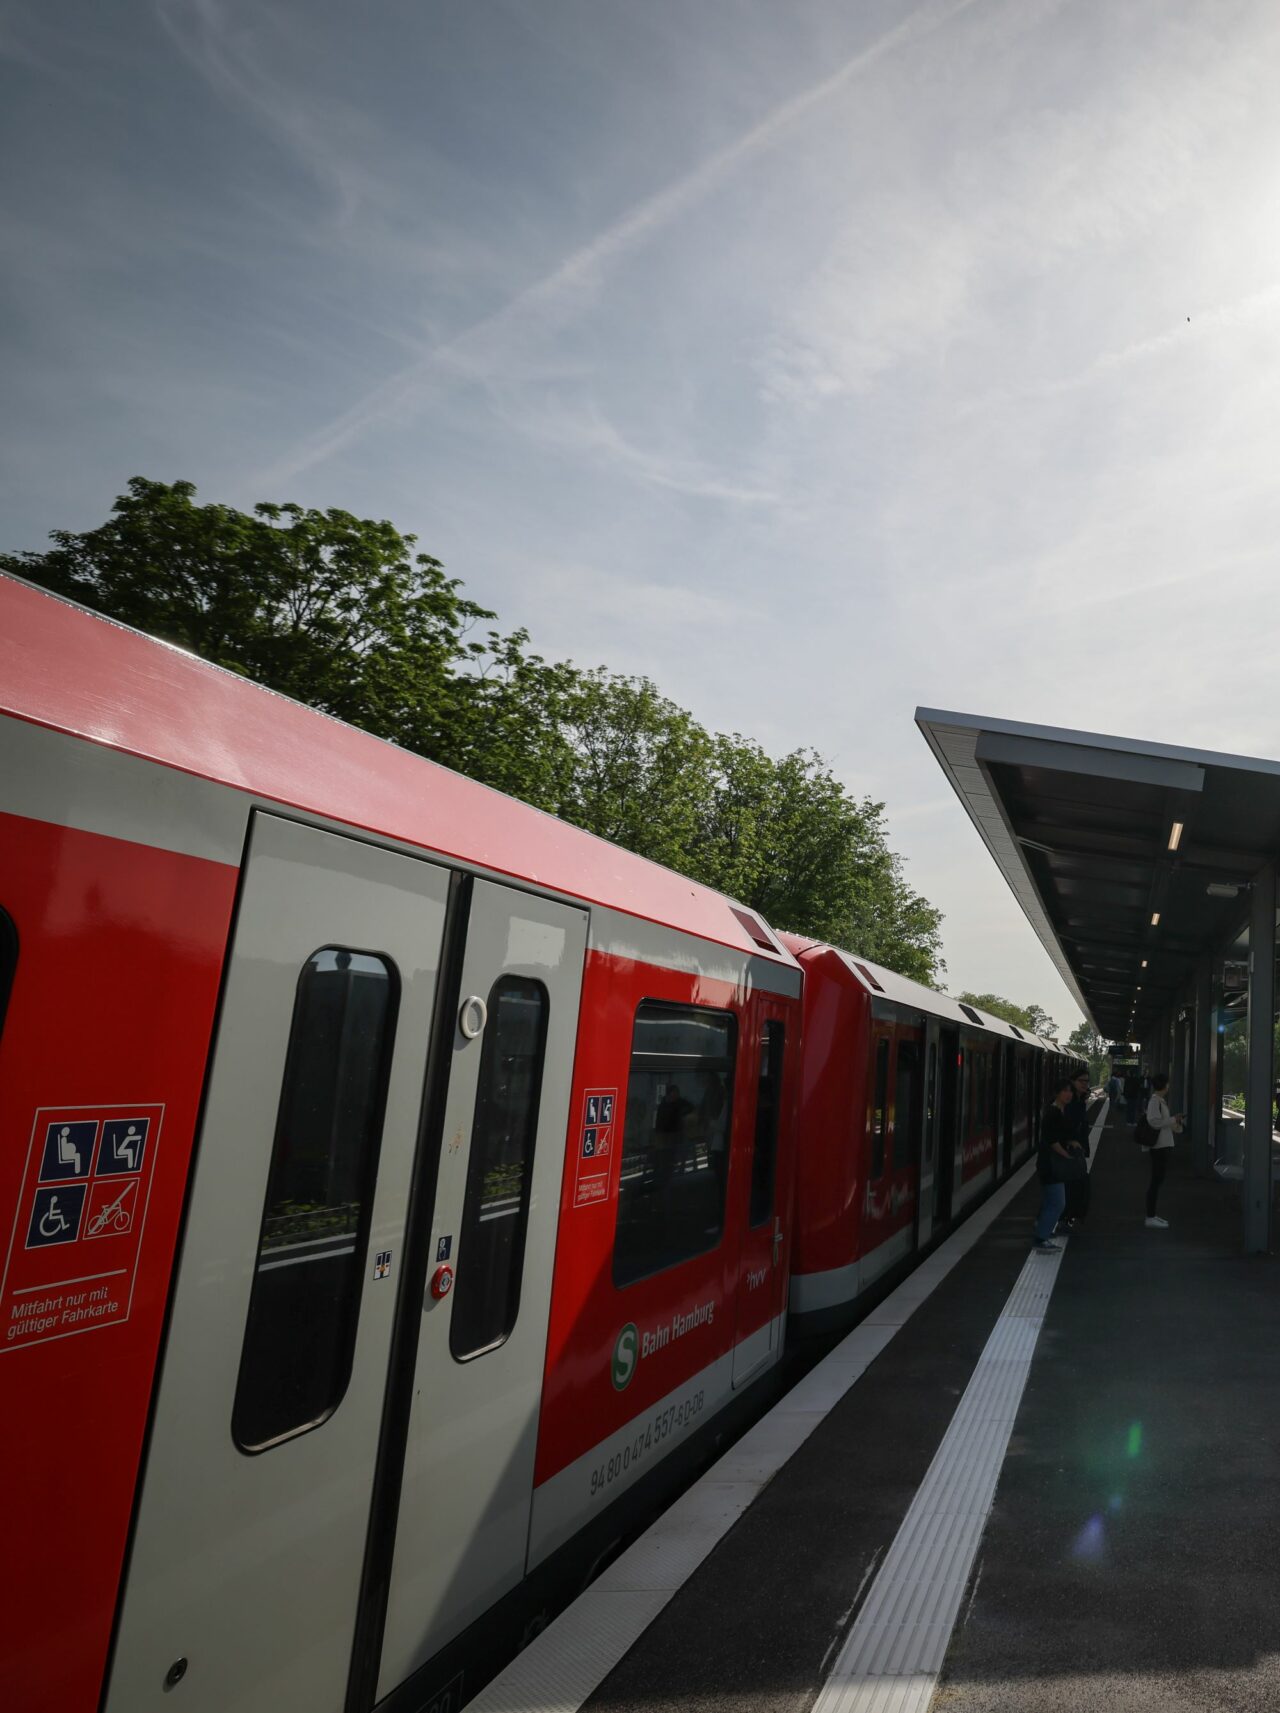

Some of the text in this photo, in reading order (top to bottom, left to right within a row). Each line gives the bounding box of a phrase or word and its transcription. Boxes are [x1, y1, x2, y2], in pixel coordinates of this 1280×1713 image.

[7, 1301, 119, 1340] gültiger Fahrkarte
[11, 1286, 109, 1320] Mitfahrt nur mit
[615, 1301, 715, 1384] S Bahn Hamburg
